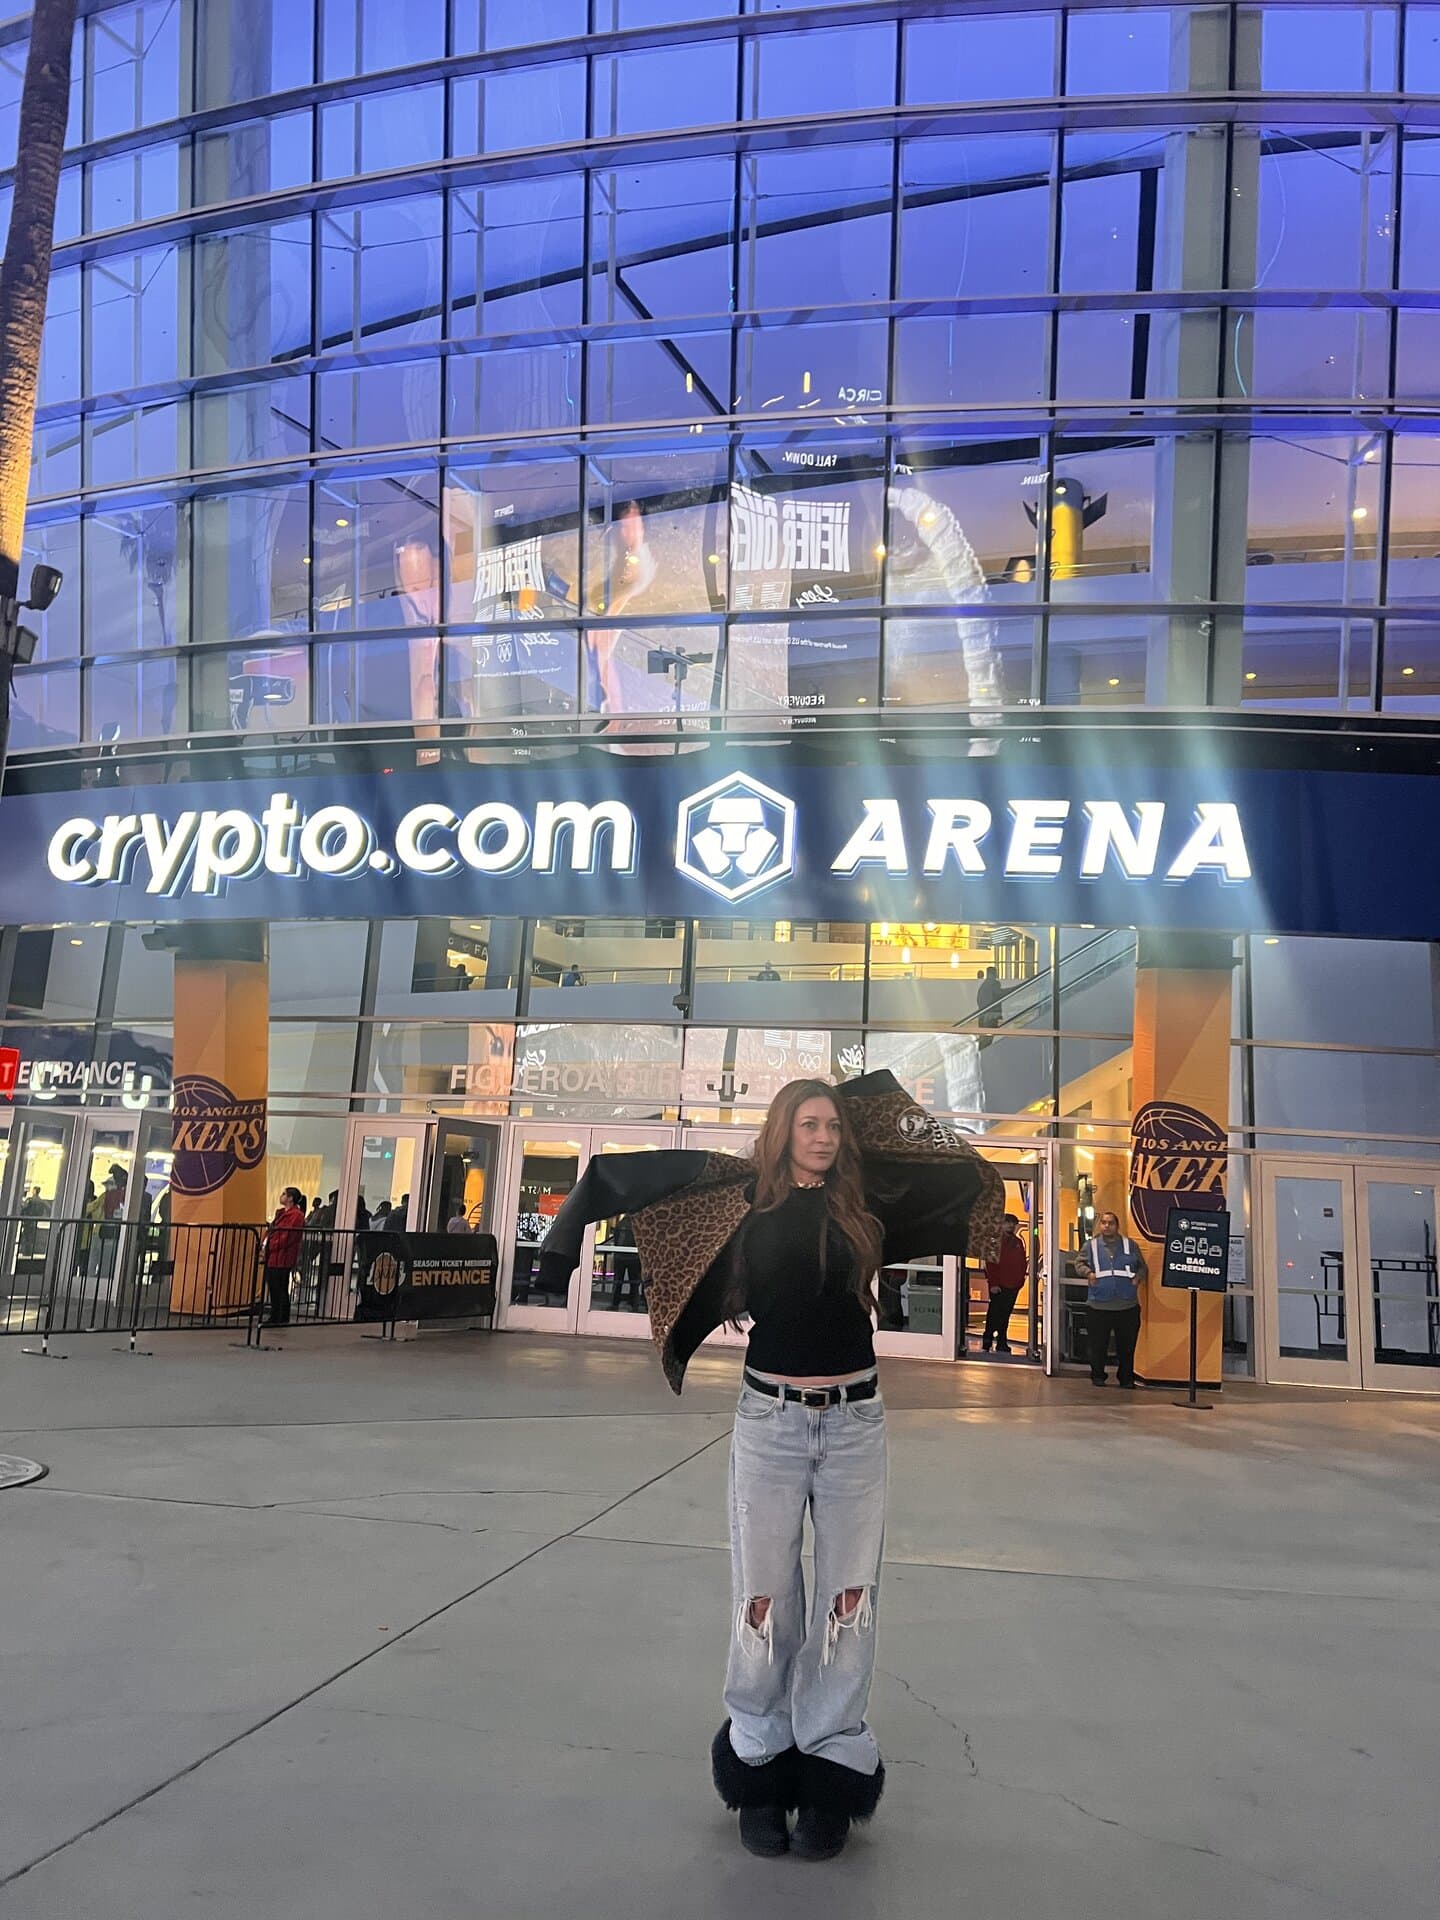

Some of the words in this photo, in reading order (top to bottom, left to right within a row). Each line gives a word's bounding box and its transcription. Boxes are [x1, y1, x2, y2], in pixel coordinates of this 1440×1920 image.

[46, 792, 639, 898] crypto.com
[830, 798, 1253, 882] ARENA
[17, 1060, 137, 1085] ENTRANCE
[450, 1064, 607, 1094] FIGUEROA
[173, 1106, 199, 1117] LOS
[200, 1103, 265, 1117] ANGELES
[171, 1117, 268, 1164] KERS
[1142, 1137, 1170, 1151] LOS
[1171, 1139, 1229, 1152] ANGE
[413, 1259, 440, 1268] SEASON
[441, 1259, 464, 1268] TICKET
[1168, 1262, 1221, 1276] SCREENING
[1186, 1256, 1206, 1266] BAG
[411, 1269, 491, 1287] ENTRANCE
